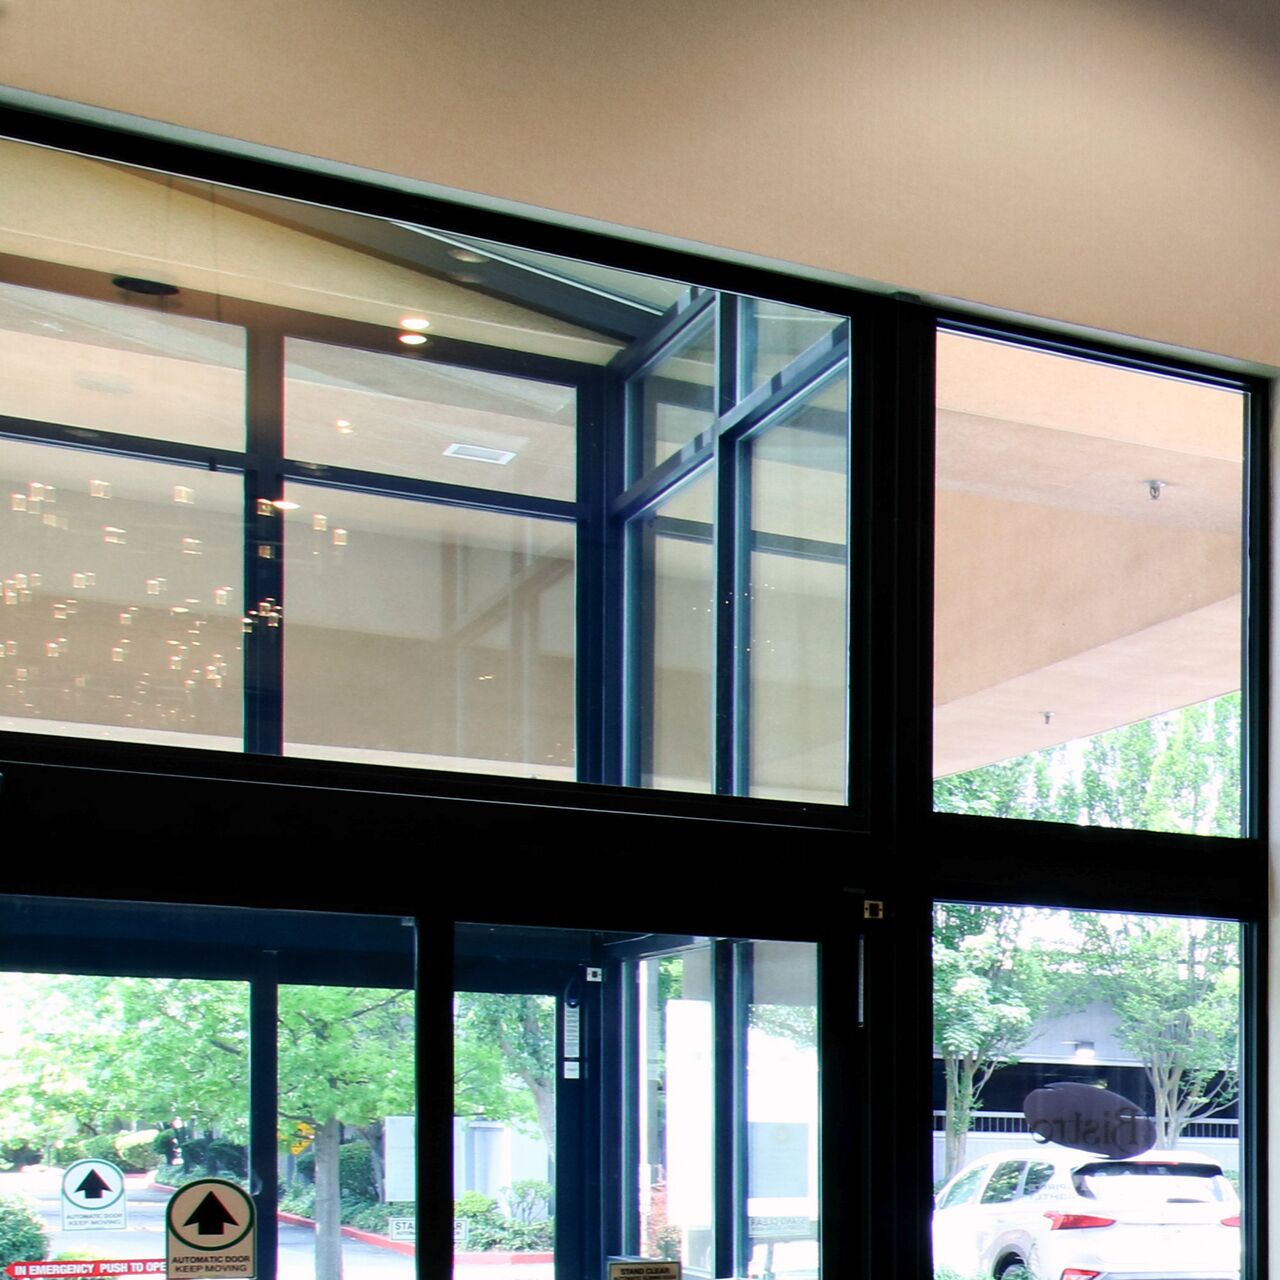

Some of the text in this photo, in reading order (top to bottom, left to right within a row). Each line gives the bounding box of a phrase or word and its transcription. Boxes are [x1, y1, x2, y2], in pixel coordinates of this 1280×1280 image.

[395, 1222, 414, 1230] STA
[172, 1255, 250, 1264] AUTOMATIC DOOR
[14, 1261, 167, 1276] IN EMERGENCY PUSH TO OPE
[175, 1264, 247, 1273] KEEP MOVING
